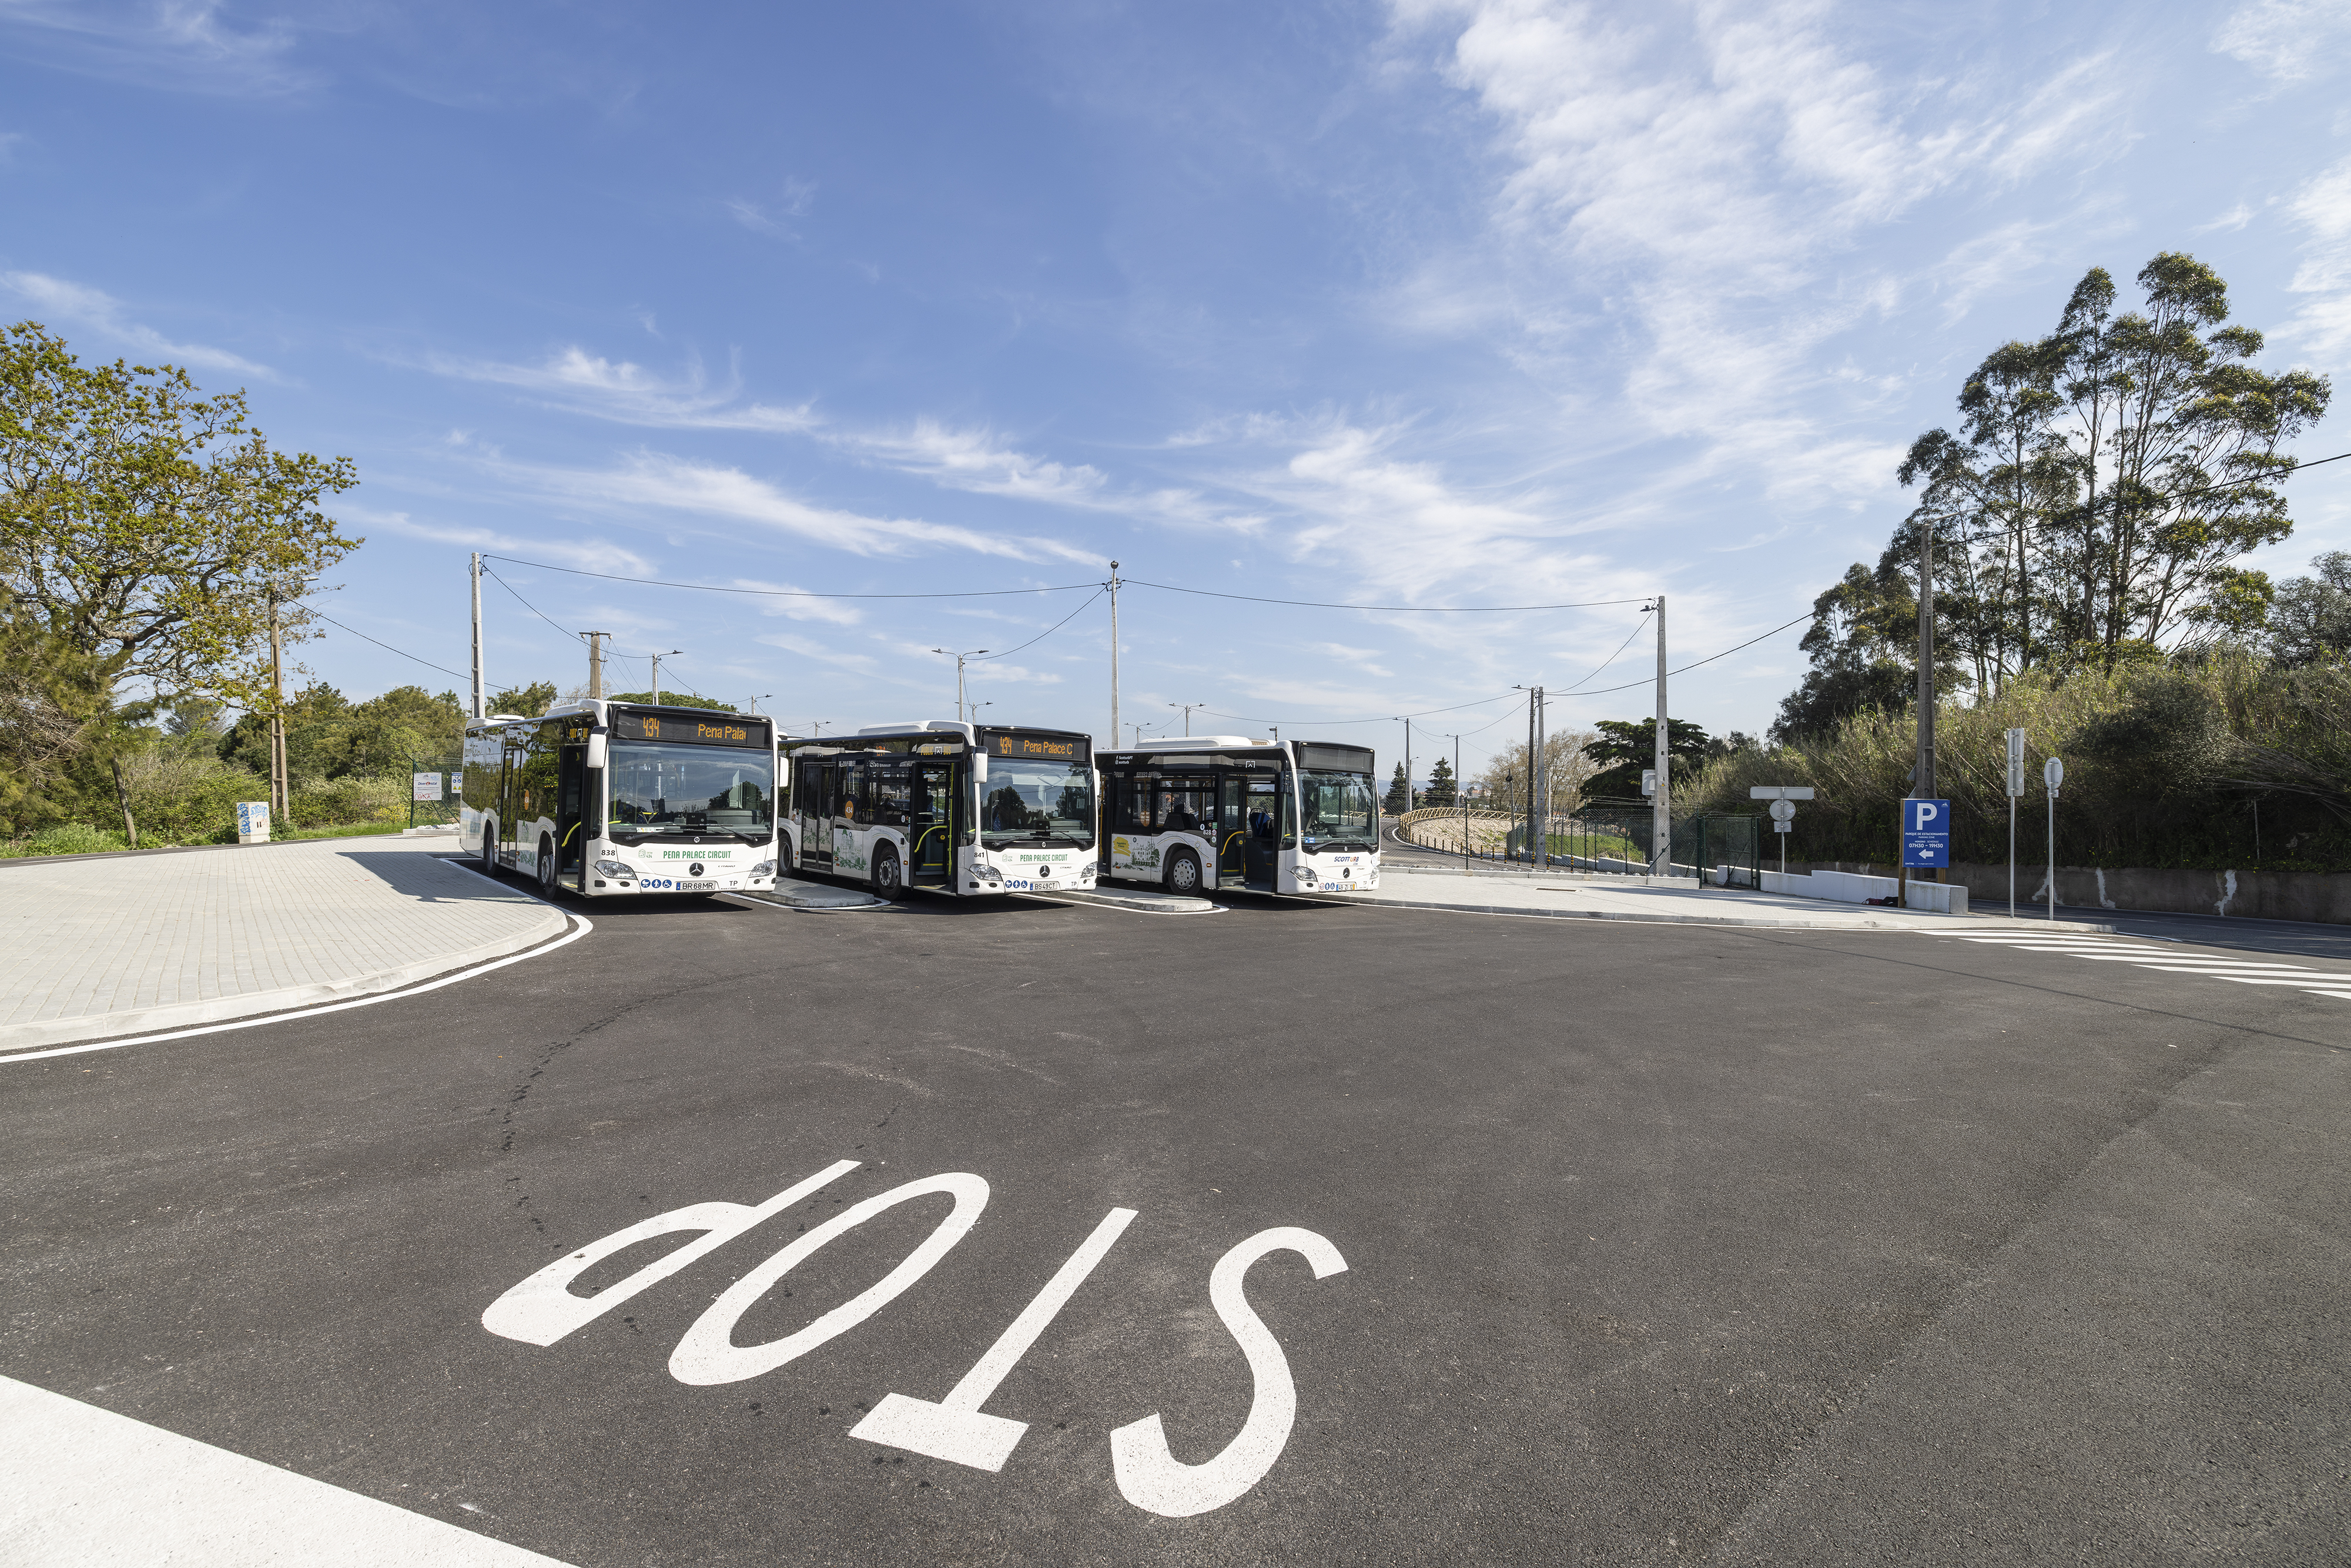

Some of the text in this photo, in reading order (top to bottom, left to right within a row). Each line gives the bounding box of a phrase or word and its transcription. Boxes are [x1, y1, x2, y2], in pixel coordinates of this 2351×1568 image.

[643, 717, 659, 738] 434
[698, 723, 722, 738] Pena
[921, 746, 933, 755] PUBLIC
[1000, 736, 1012, 754] 434
[1024, 740, 1073, 755] Pena Palace C
[1917, 803, 1937, 830] P
[481, 1160, 1348, 1519] STOP
